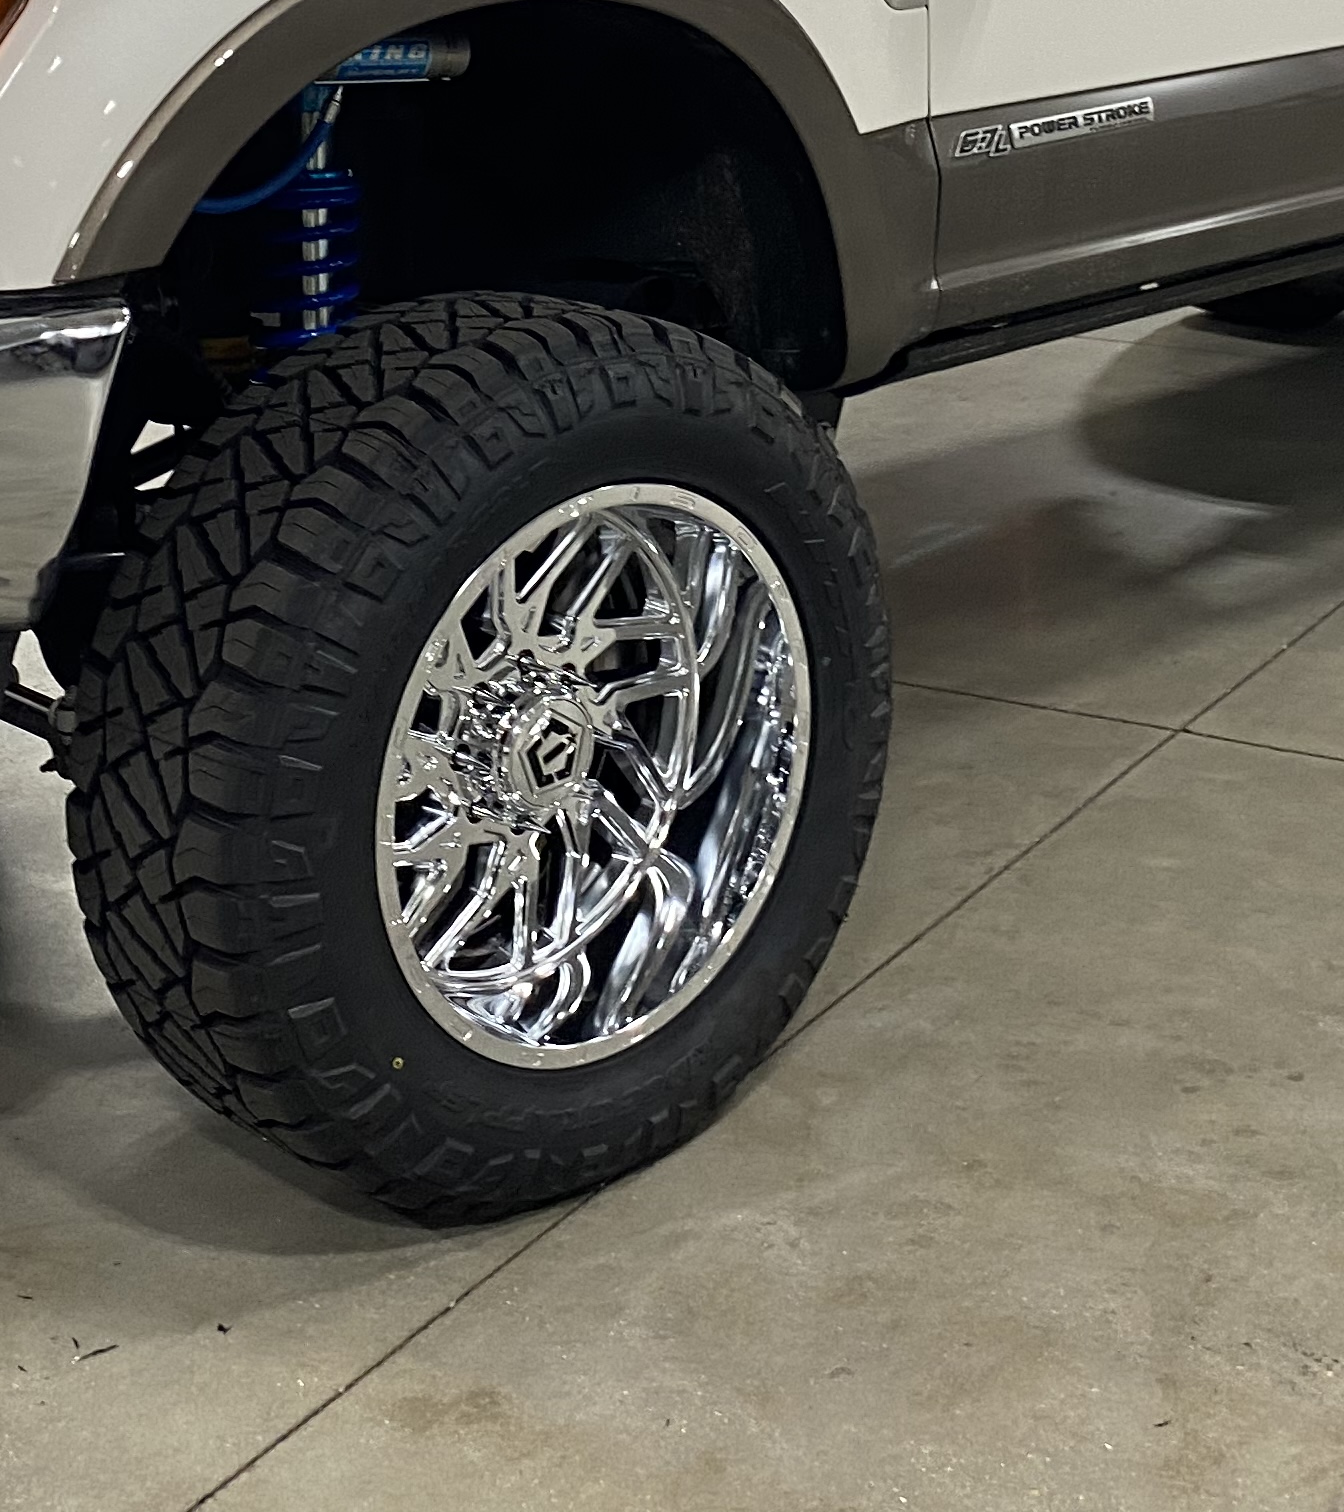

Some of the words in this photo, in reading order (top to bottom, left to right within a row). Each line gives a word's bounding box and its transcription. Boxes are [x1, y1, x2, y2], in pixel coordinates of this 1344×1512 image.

[346, 44, 429, 64] ING
[1017, 115, 1080, 139] POWER
[1083, 101, 1152, 127] STROKE
